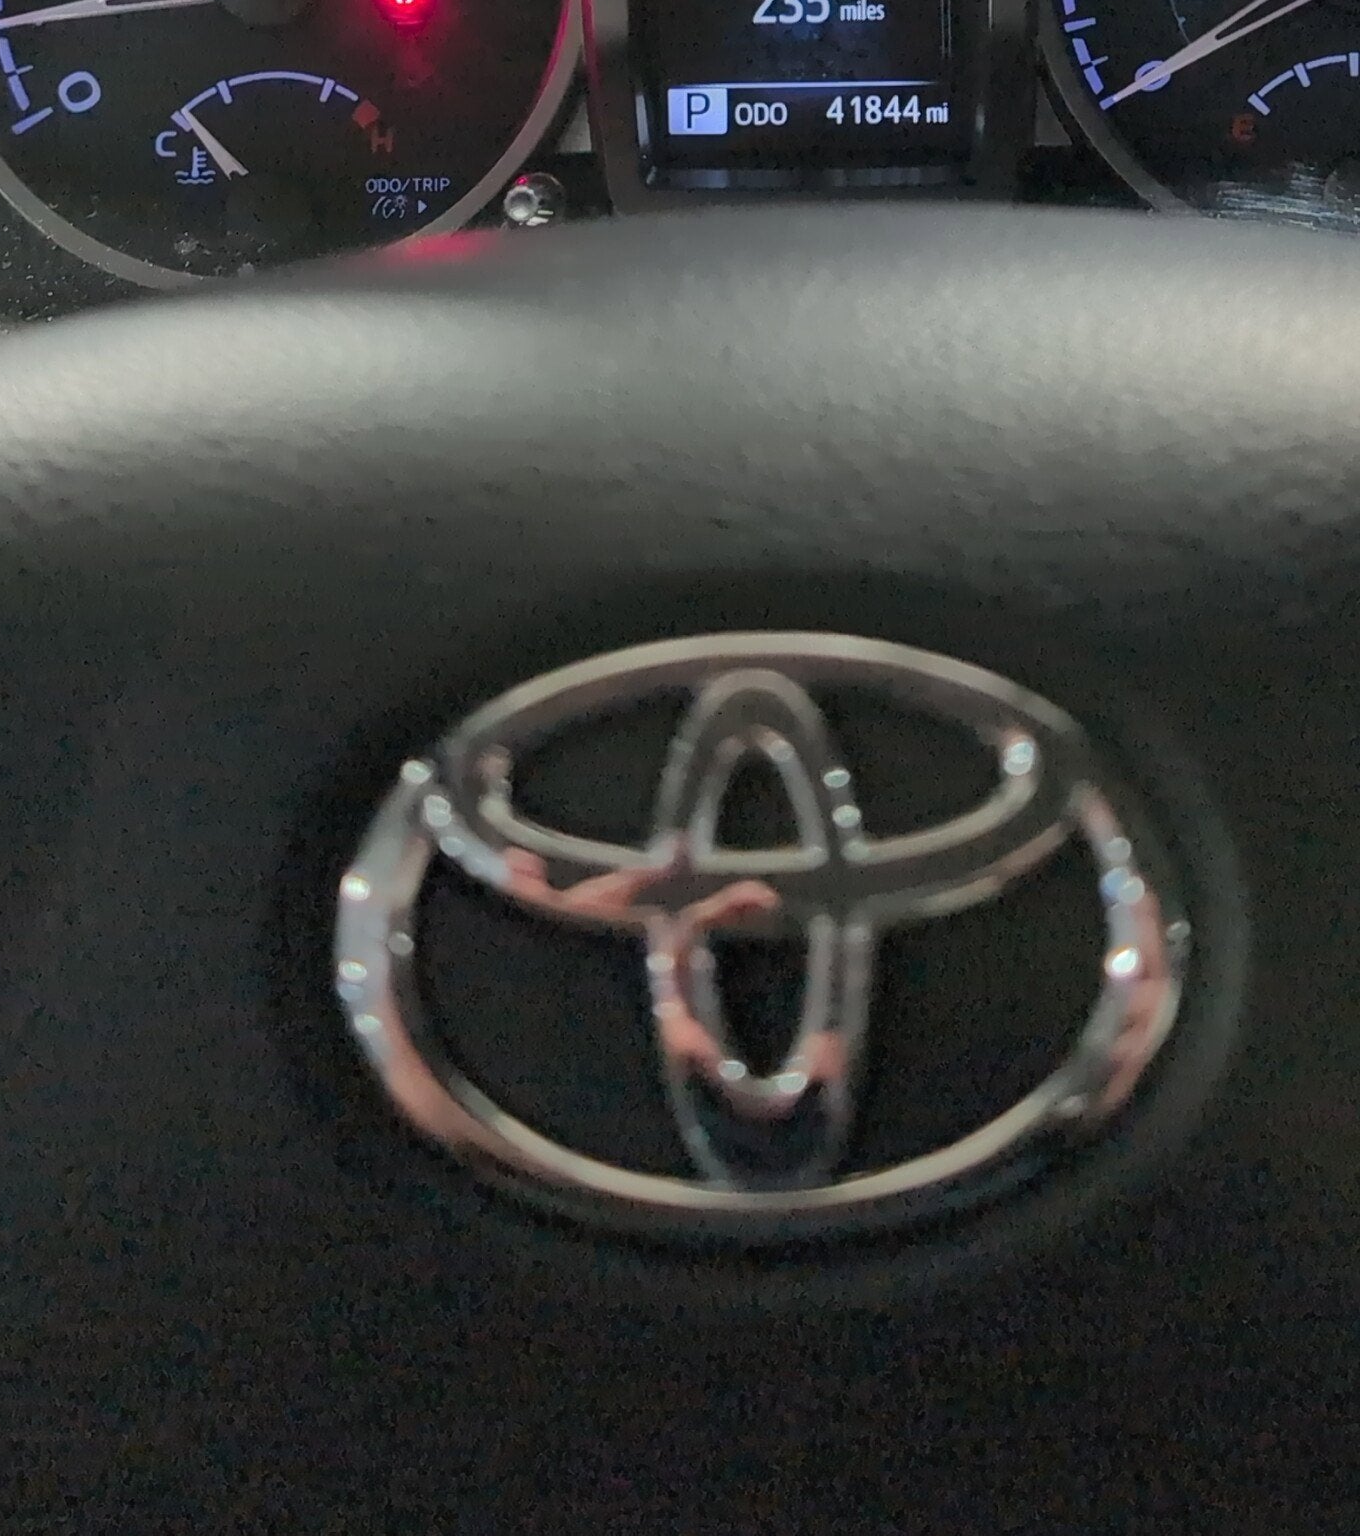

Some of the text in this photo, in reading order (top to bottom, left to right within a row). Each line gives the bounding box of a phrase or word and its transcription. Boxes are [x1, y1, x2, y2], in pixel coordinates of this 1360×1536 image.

[840, 0, 885, 21] miles
[58, 70, 101, 114] 0
[685, 92, 950, 130] P ODO 41844 mi
[154, 130, 178, 157] C
[370, 127, 394, 153] H
[364, 176, 452, 194] ODO/TRIP
